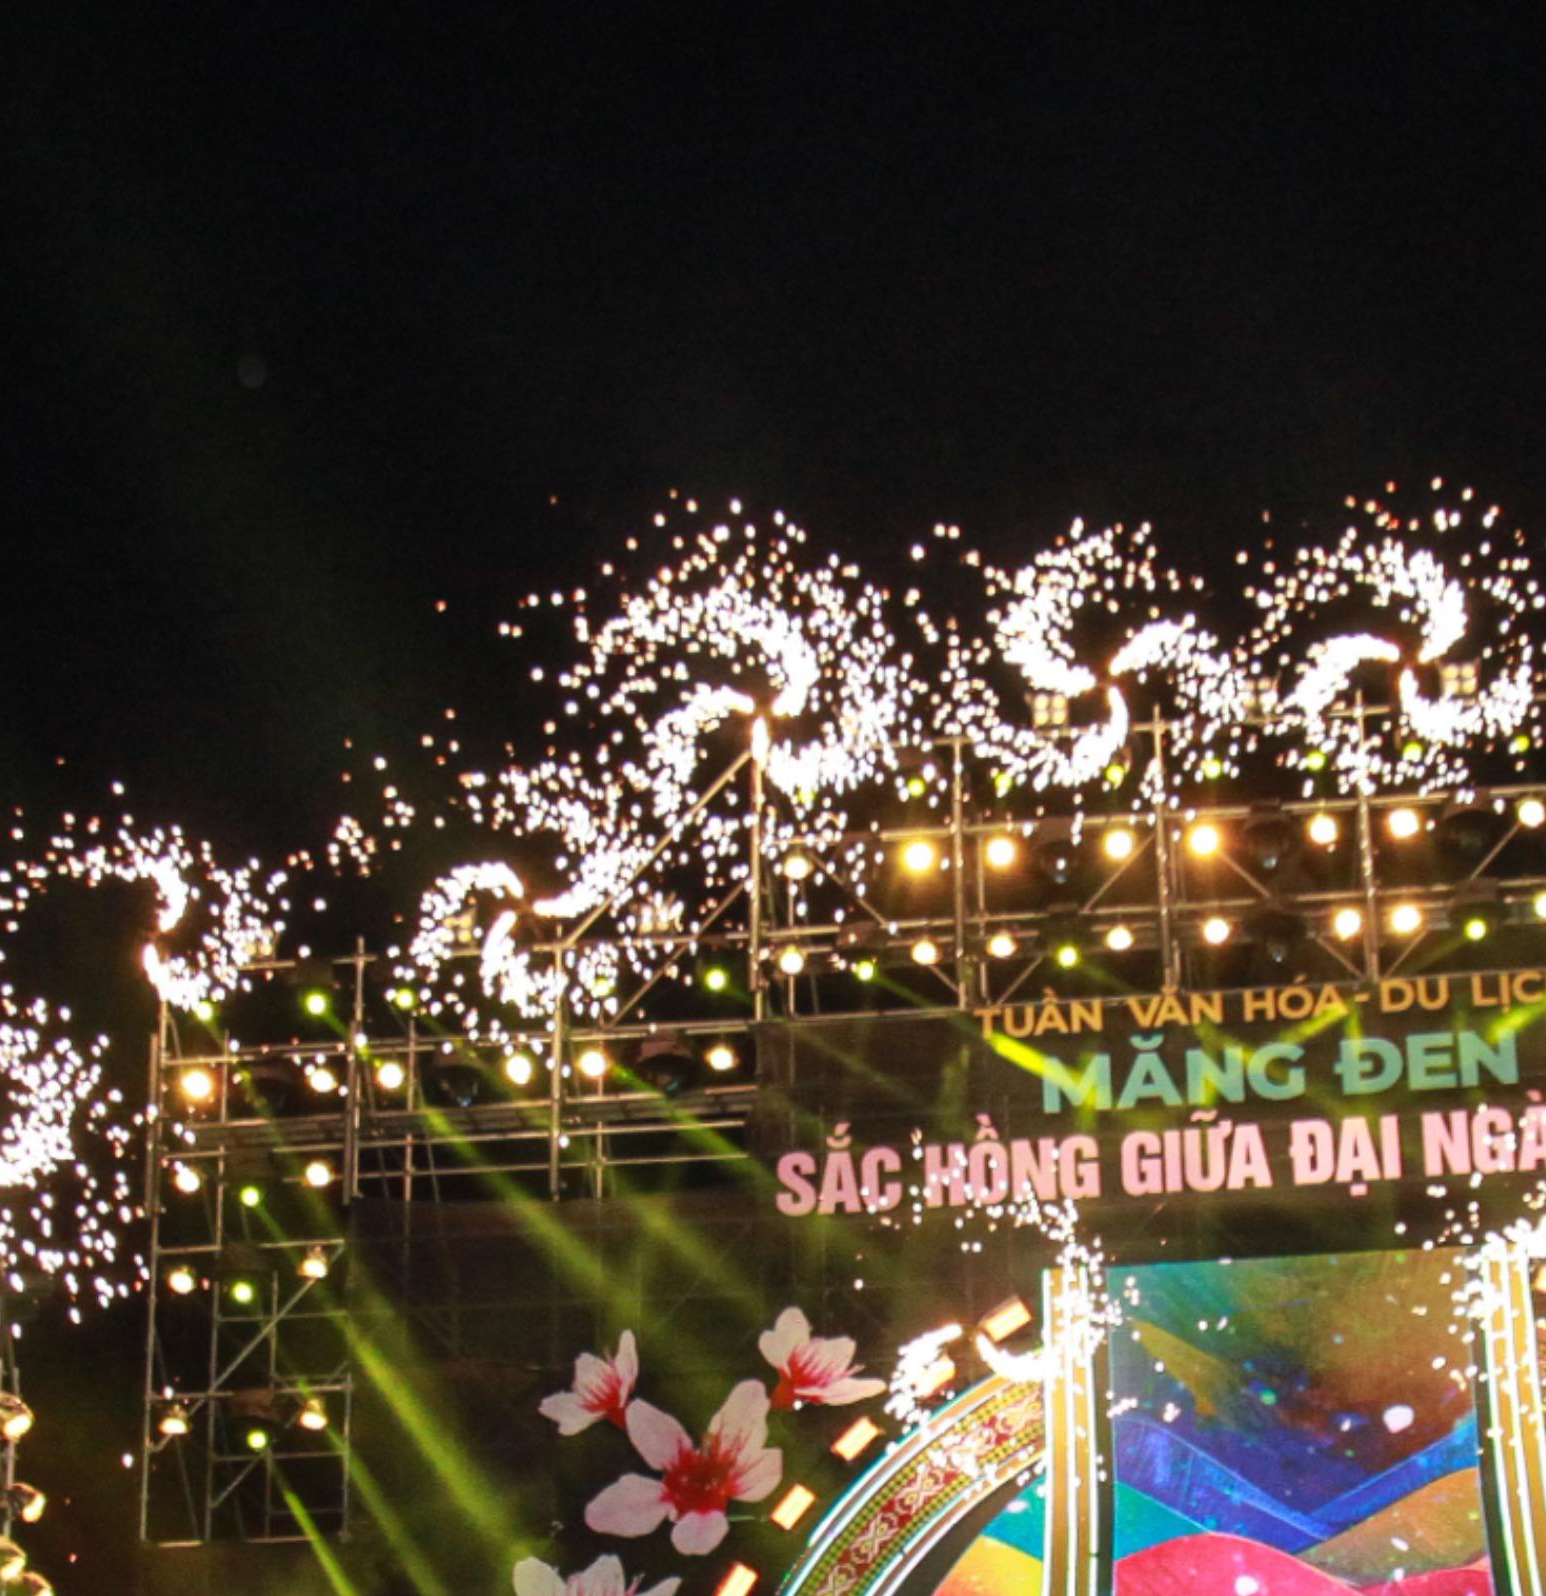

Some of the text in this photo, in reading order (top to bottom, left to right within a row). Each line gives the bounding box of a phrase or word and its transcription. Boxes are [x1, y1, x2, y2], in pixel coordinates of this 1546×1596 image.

[974, 987, 1104, 1039] TUẦN
[1128, 989, 1223, 1028] VĂN
[1244, 974, 1350, 1022] HÓA
[1381, 976, 1449, 1013] DU
[1043, 1028, 1519, 1114] MĂNG ĐEN
[776, 1121, 903, 1217] SẮC
[924, 1113, 1101, 1208] HỒNG
[1121, 1110, 1273, 1196] GIỮA
[1289, 1114, 1402, 1196] ĐẠI
